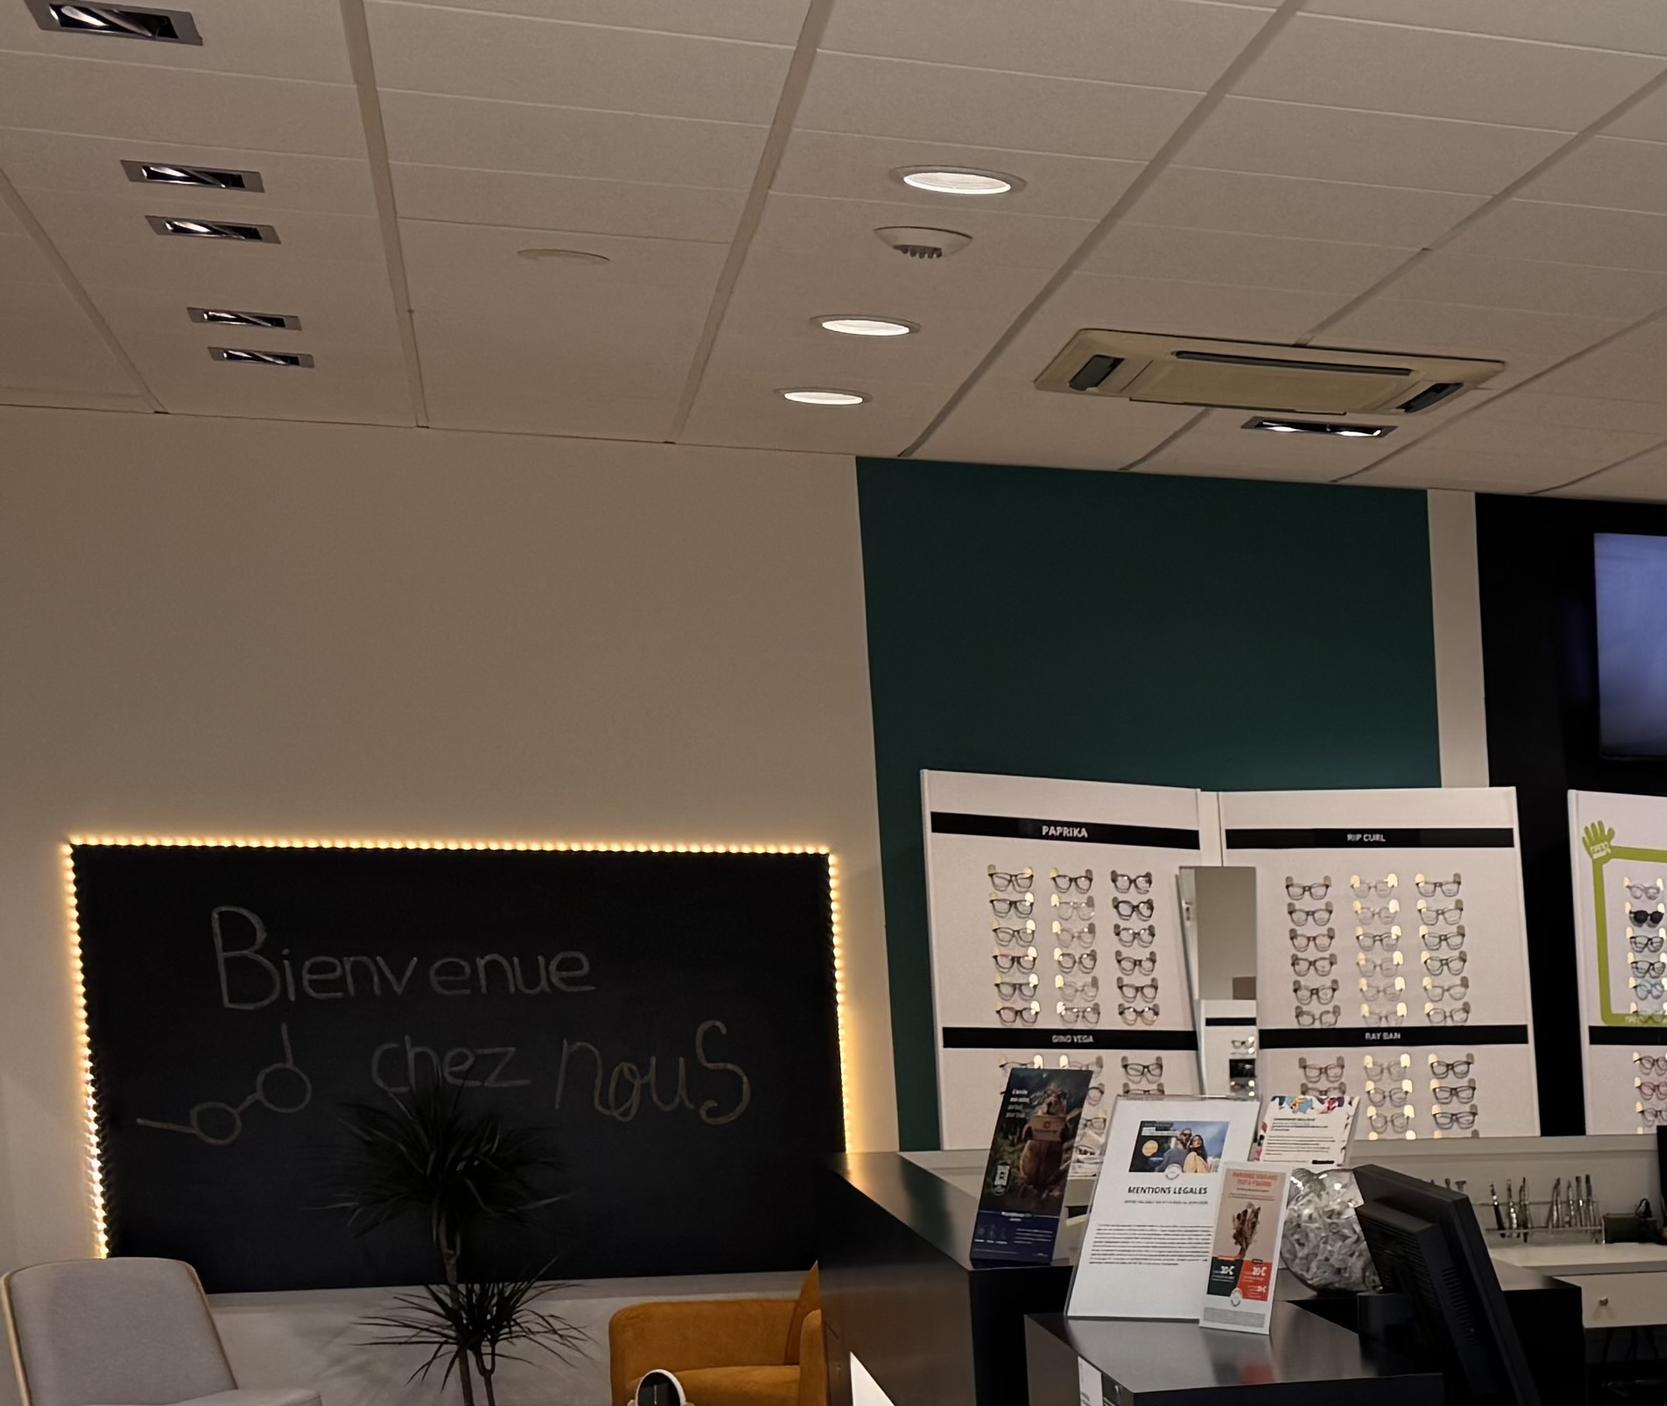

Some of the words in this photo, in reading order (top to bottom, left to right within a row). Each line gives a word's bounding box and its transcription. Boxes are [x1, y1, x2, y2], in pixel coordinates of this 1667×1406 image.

[1041, 825, 1089, 838] PAPRIKA
[211, 904, 598, 1012] Bienvenue
[371, 1033, 532, 1098] chez
[1127, 1186, 1171, 1195] MENTIONS
